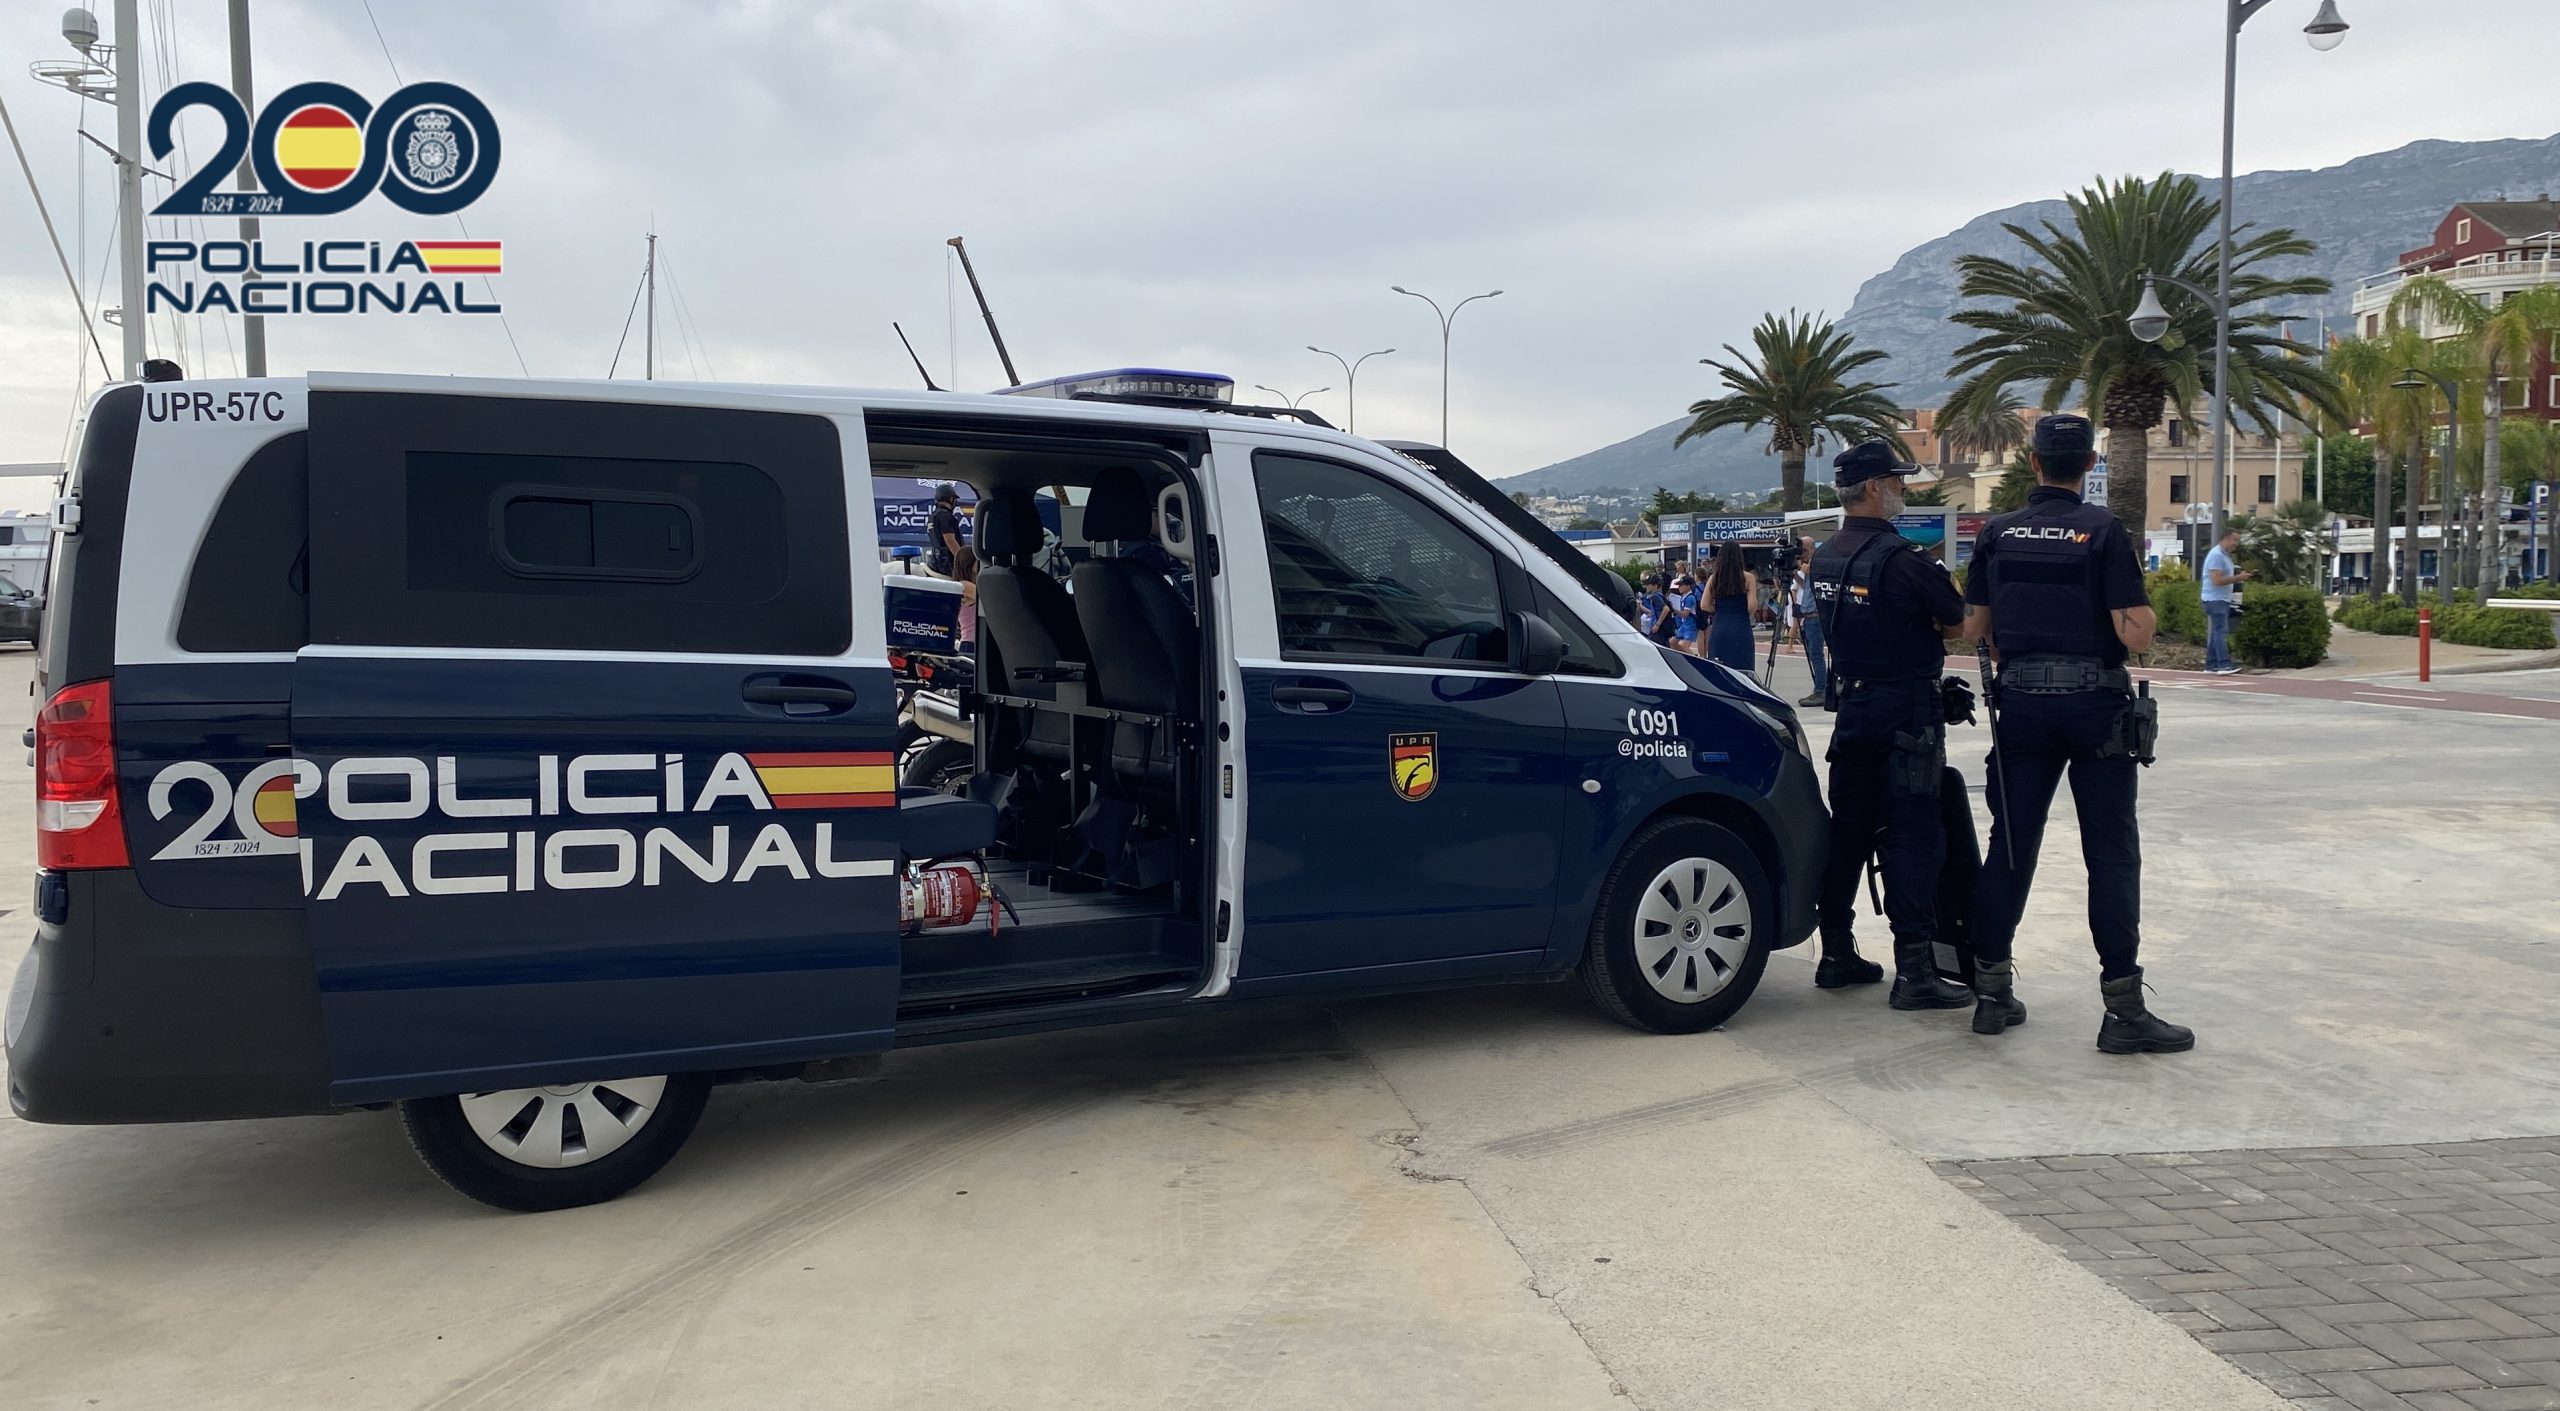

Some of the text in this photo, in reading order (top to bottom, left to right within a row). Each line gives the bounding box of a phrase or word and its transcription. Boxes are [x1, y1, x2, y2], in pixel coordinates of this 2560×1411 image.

[147, 391, 285, 422] UPR-57C
[2088, 481, 2102, 494] 24
[1707, 519, 1779, 530] EXCURSIONES
[1703, 531, 1718, 540] EN
[893, 626, 949, 639] NACIONAL
[1640, 709, 1679, 736] 091
[1618, 738, 1688, 760] @policia
[194, 841, 261, 856] 1824 2024
